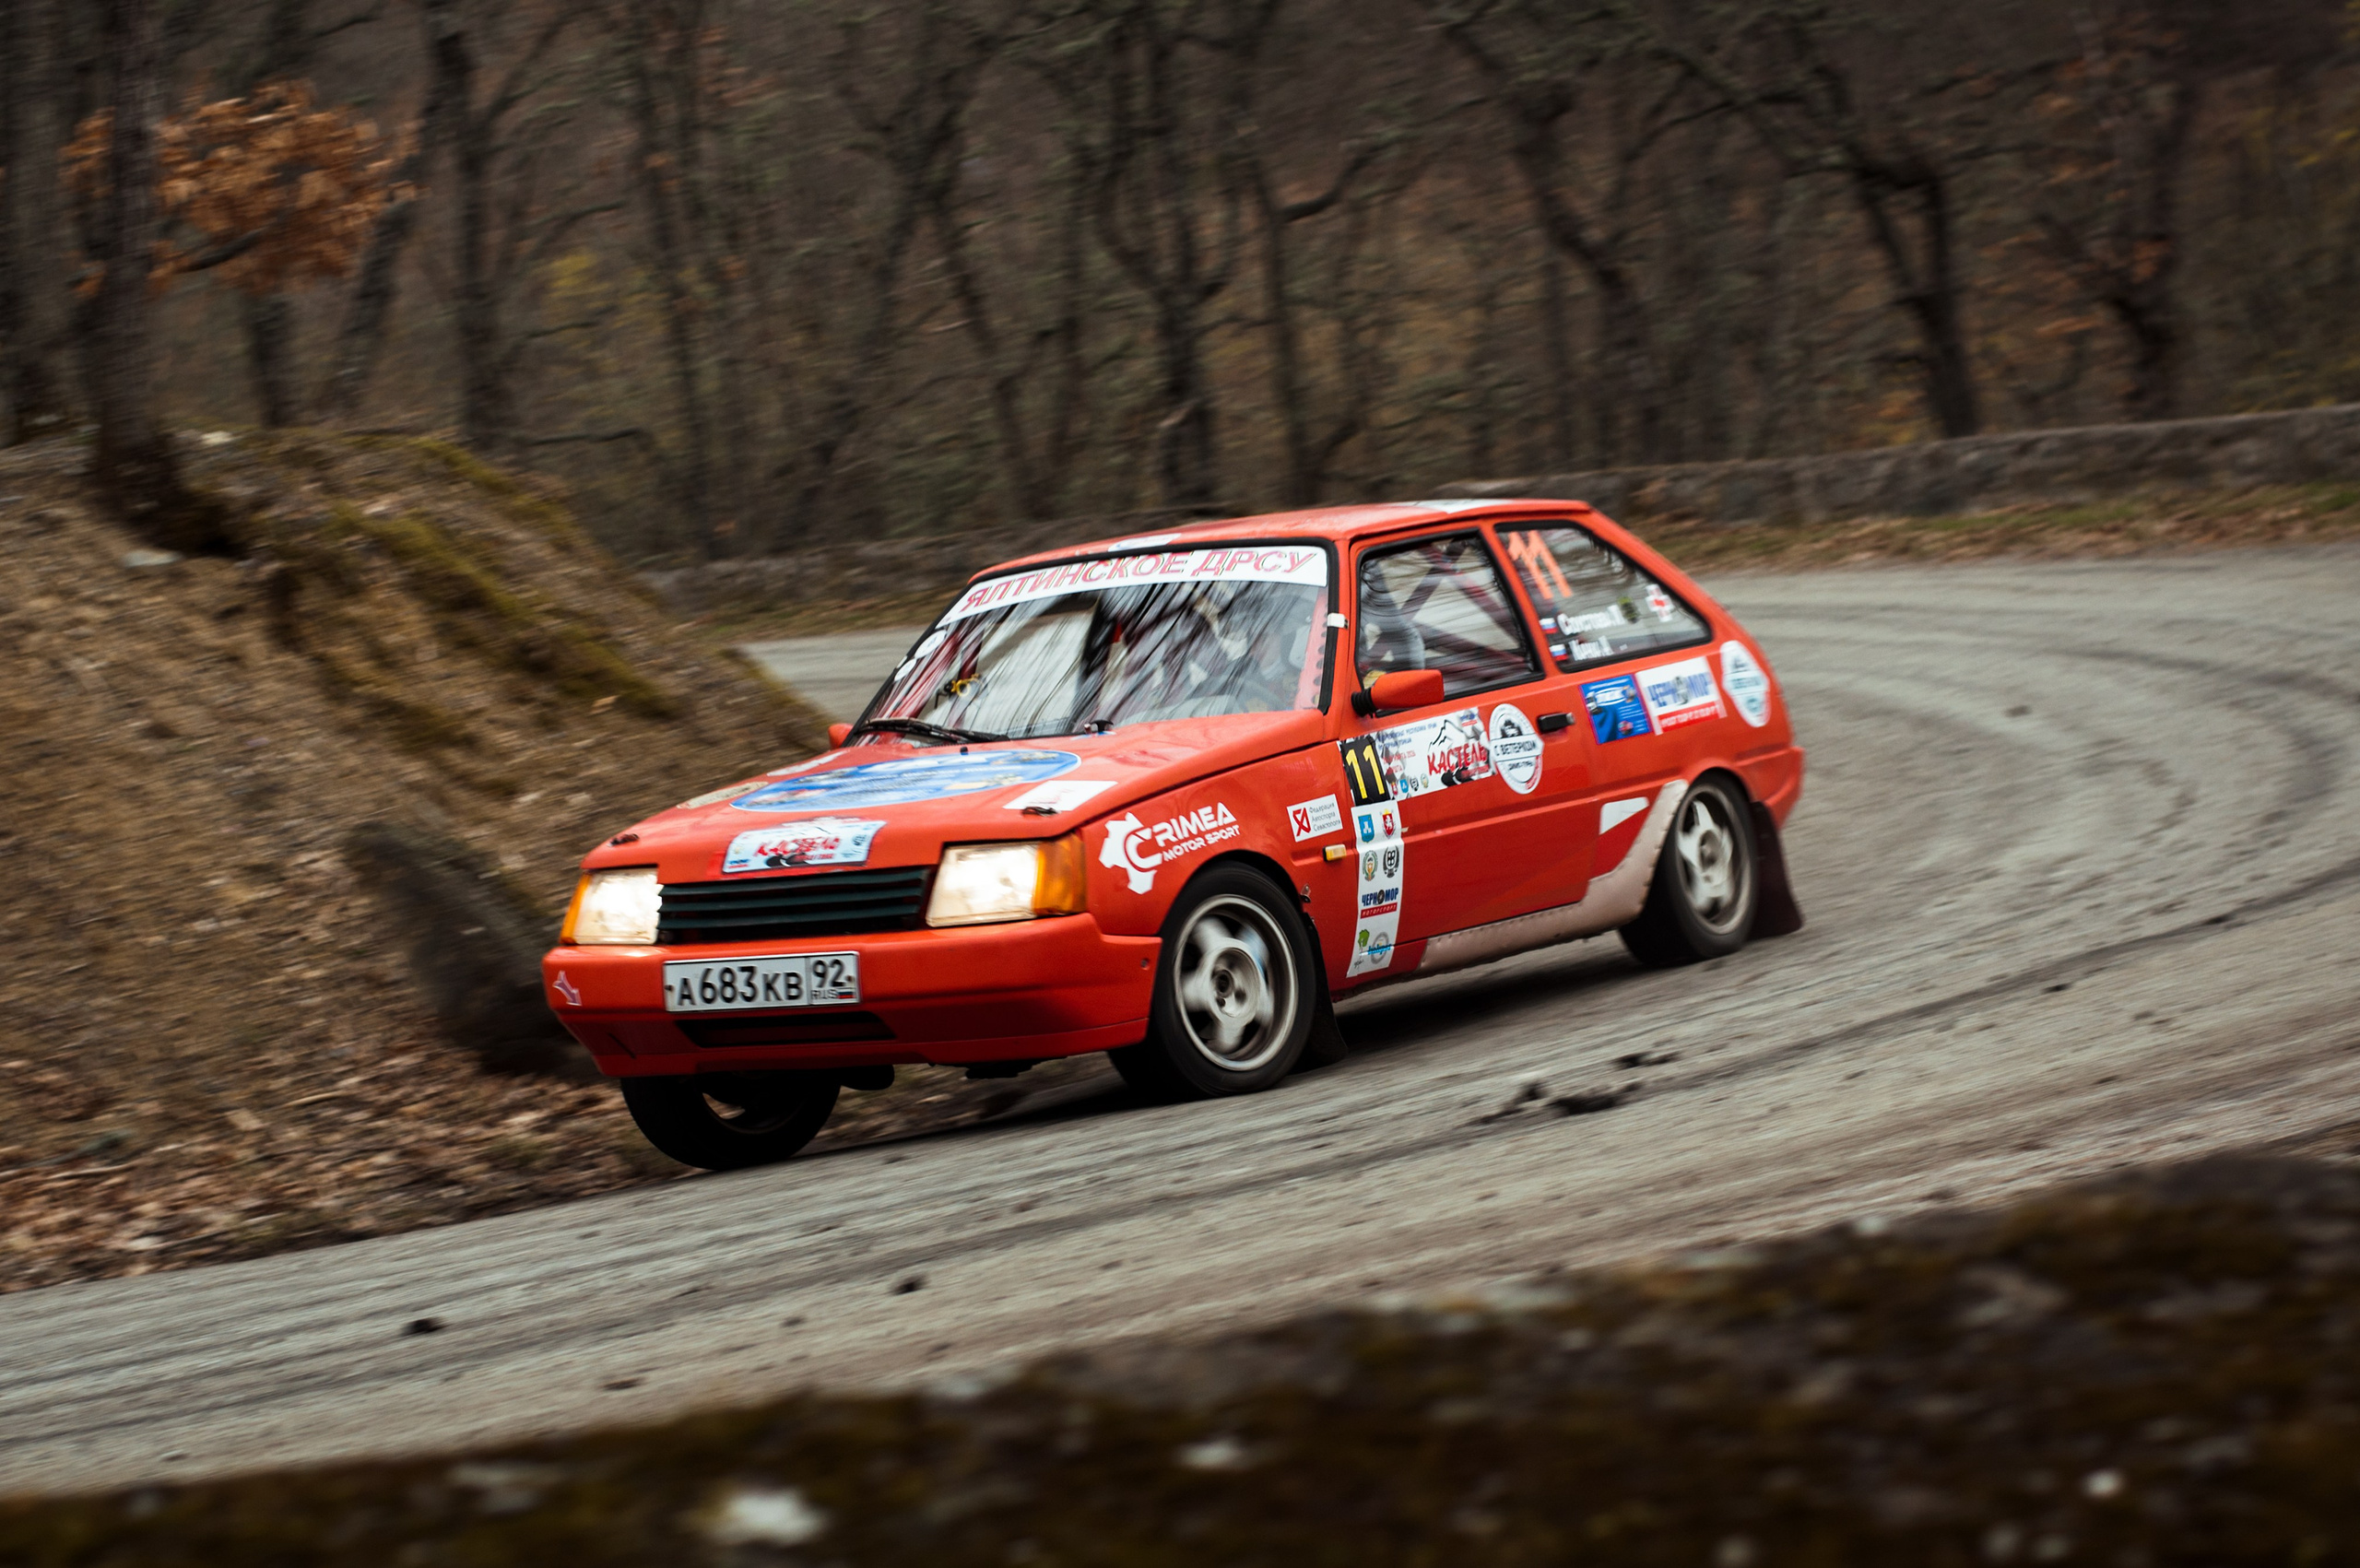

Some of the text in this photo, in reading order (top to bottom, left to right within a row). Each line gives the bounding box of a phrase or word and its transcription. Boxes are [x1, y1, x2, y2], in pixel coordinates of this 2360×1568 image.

[959, 548, 1318, 614] ЯЛТИНСКОЕ ДРСУ
[1507, 530, 1573, 599] 11
[1345, 744, 1386, 800] 11
[1125, 801, 1238, 868] CRIMEA
[1162, 824, 1240, 862] MOTOR SPORT
[811, 959, 847, 988] 92
[811, 988, 837, 1001] RUS
